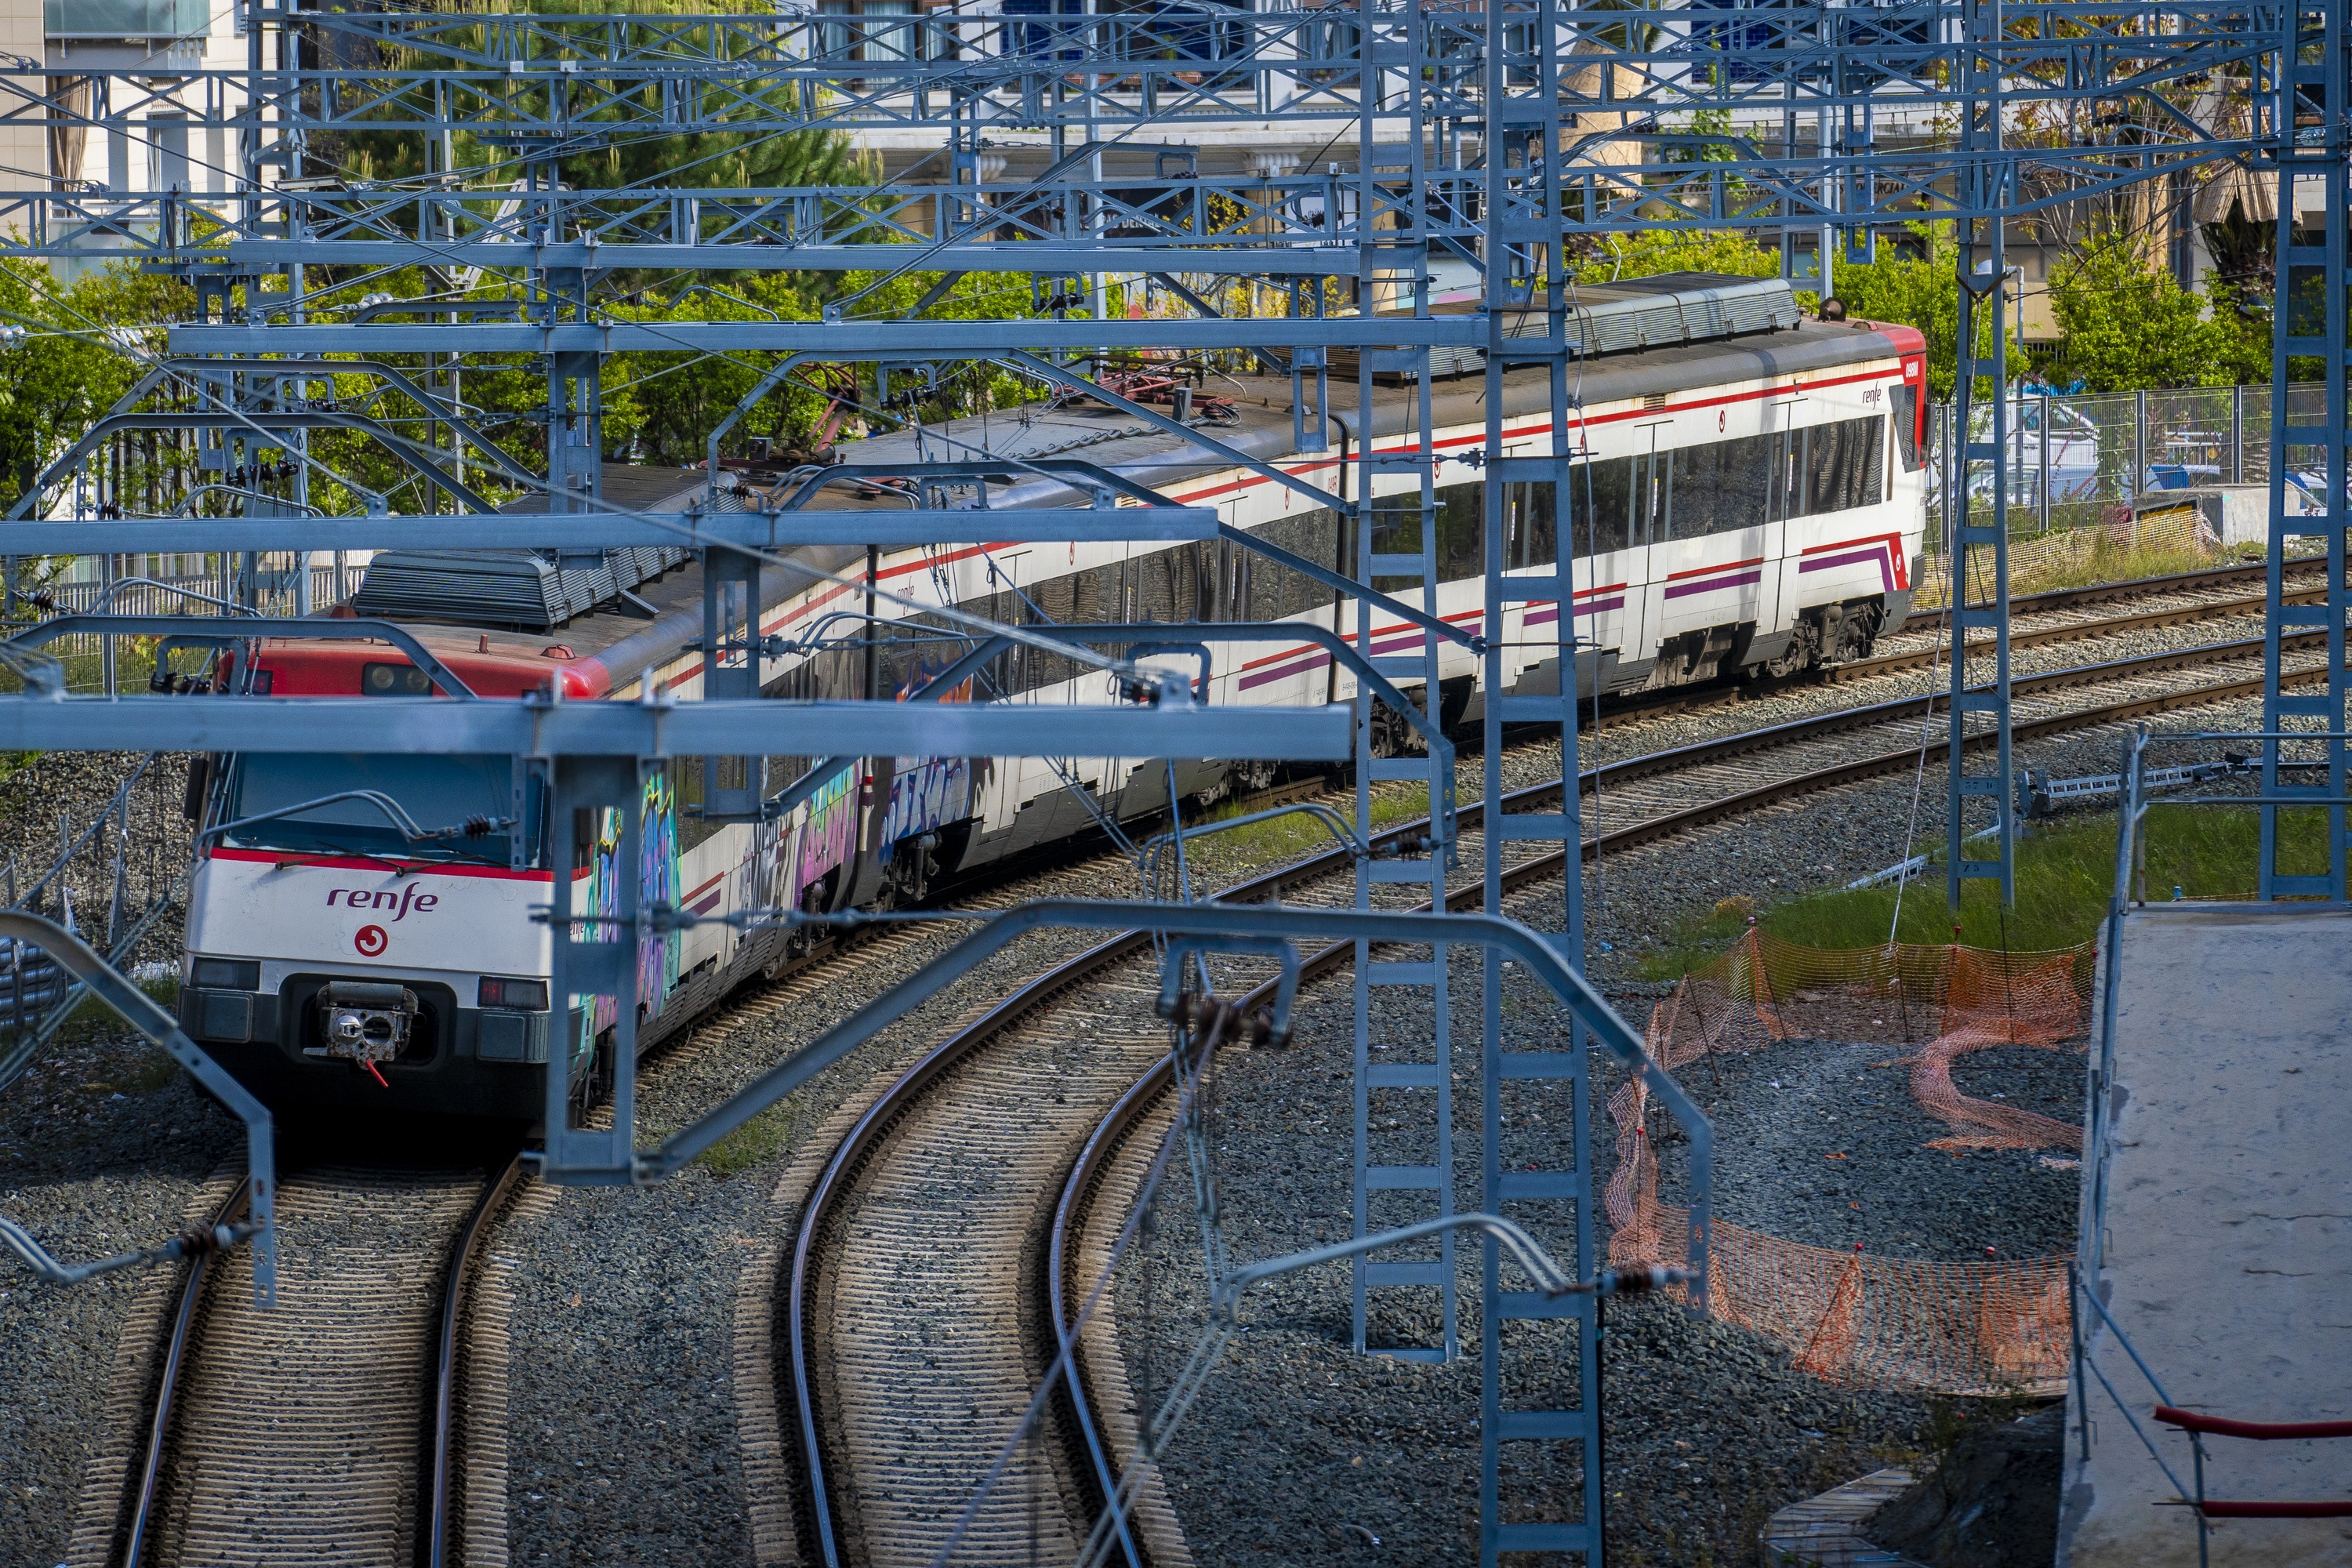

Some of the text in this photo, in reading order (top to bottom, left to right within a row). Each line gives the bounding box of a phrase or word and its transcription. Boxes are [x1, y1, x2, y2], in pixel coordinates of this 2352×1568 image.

[1905, 361, 1919, 378] 098M
[1862, 380, 1882, 410] renfe
[896, 575, 915, 612] renfe
[327, 881, 439, 922] renfe
[569, 910, 585, 943] enfe
